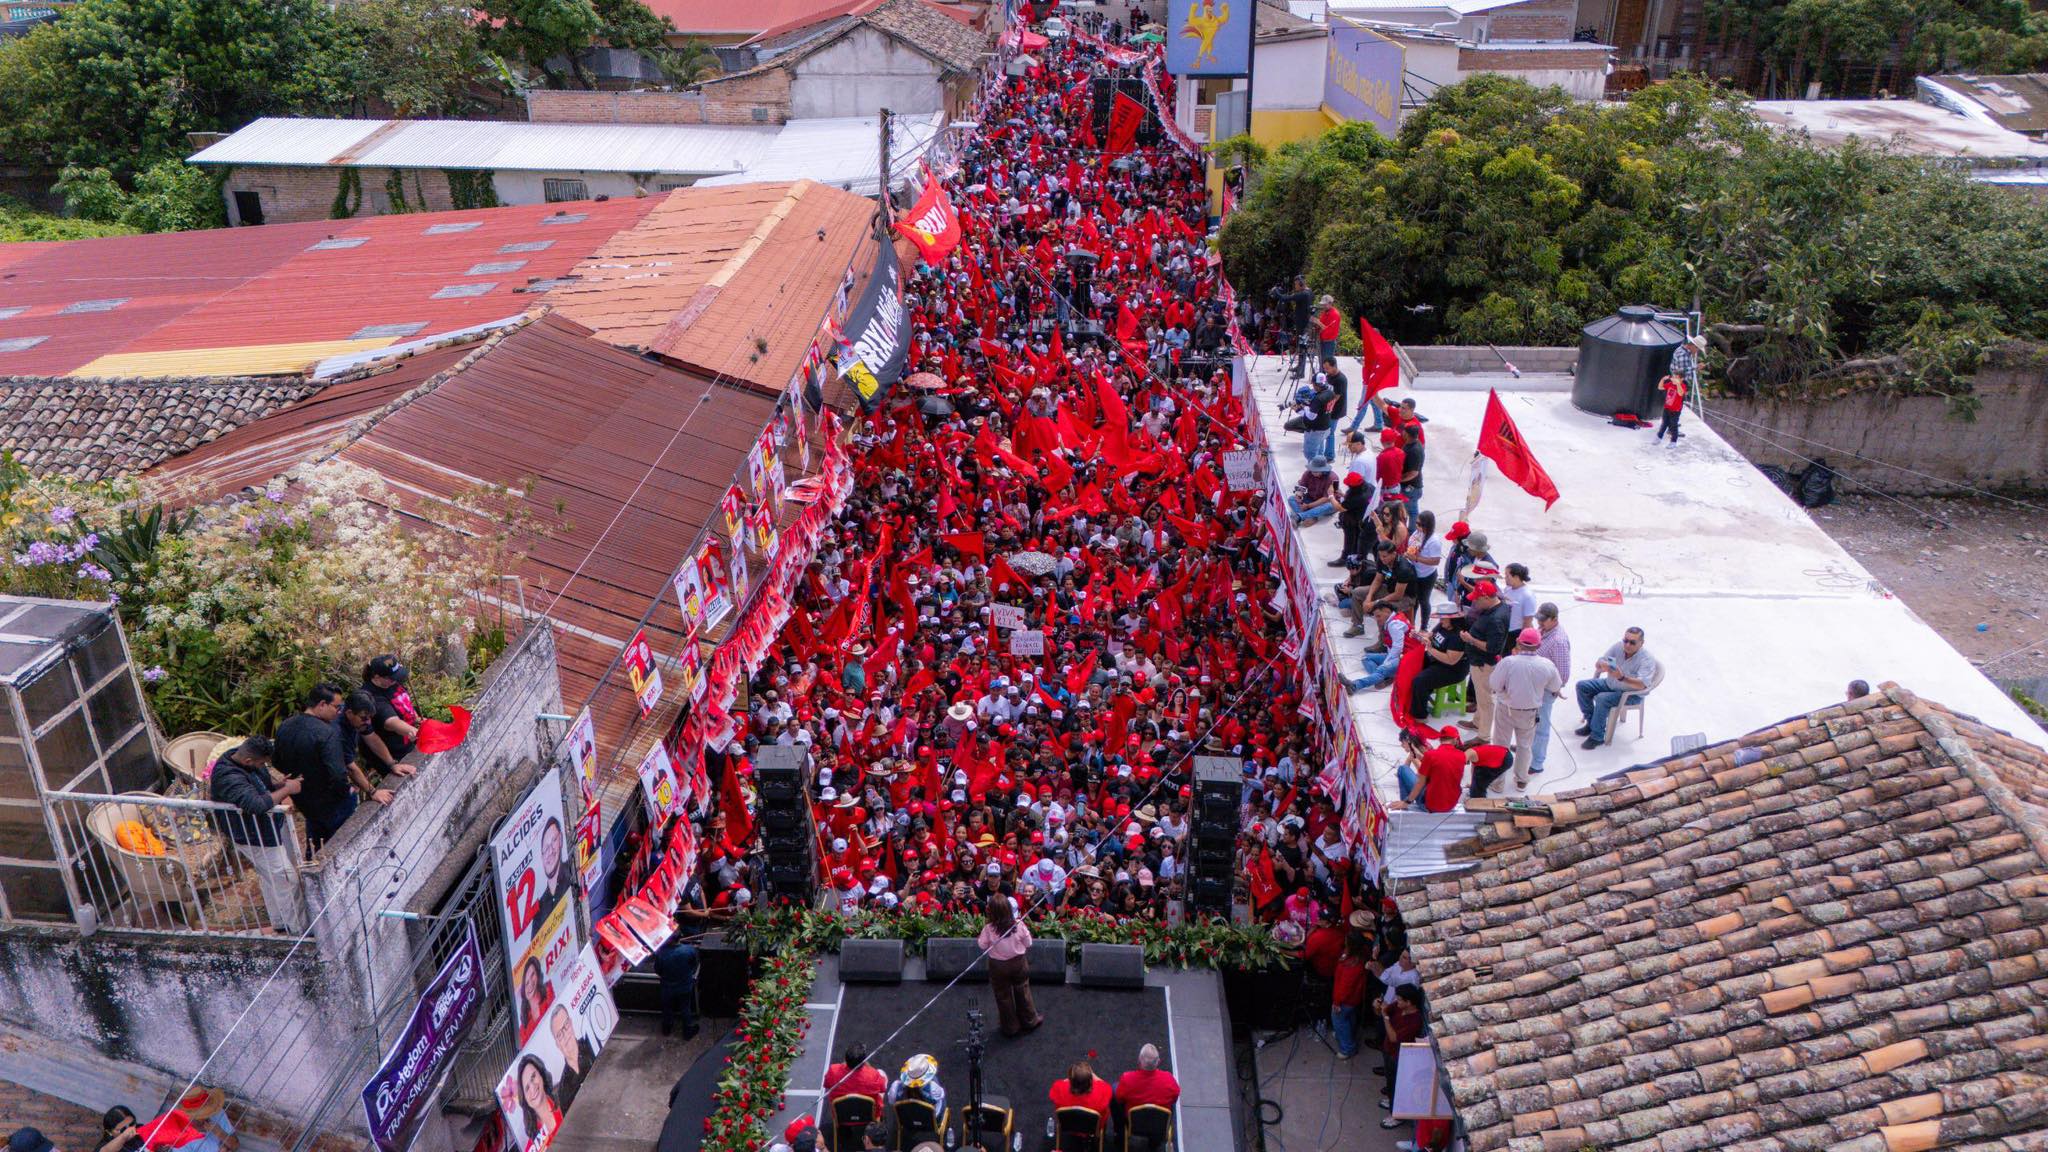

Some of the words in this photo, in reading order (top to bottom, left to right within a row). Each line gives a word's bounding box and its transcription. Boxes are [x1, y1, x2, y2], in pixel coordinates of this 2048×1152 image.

[854, 317, 895, 375] RIXI
[500, 803, 543, 868] ALCIDES
[506, 867, 540, 942] 12
[445, 1019, 459, 1044] EN
[582, 992, 612, 1057] 10
